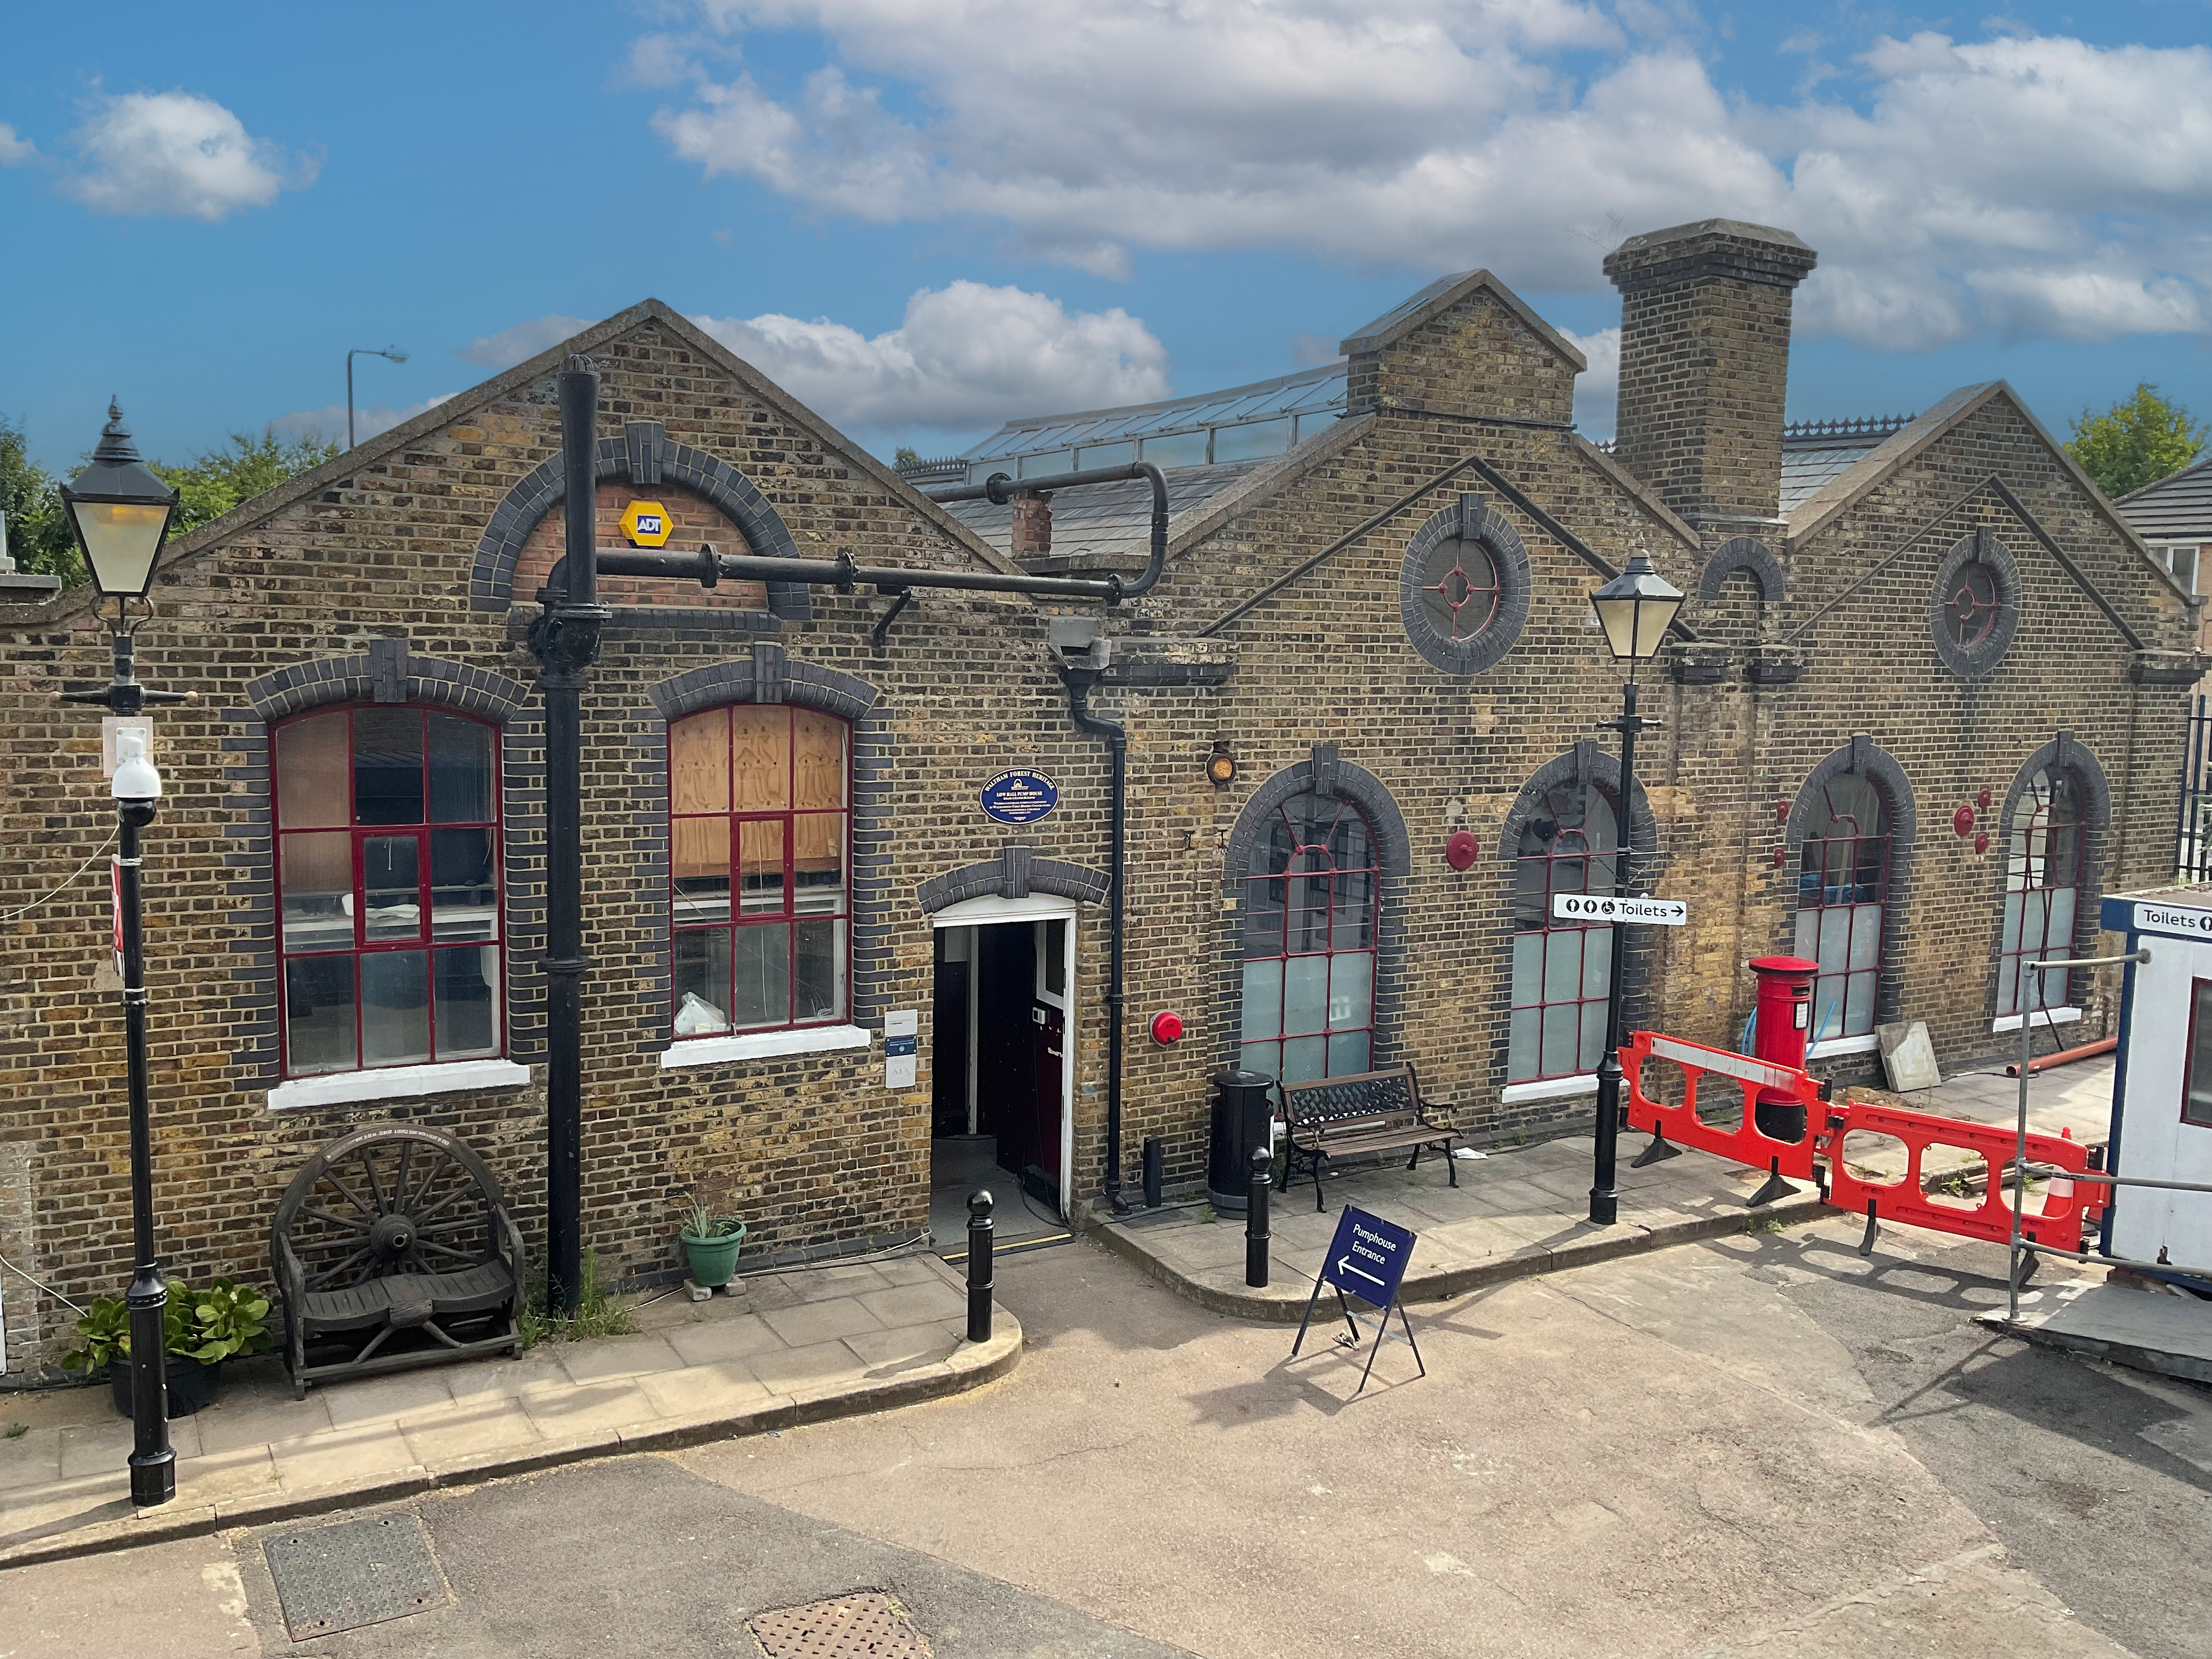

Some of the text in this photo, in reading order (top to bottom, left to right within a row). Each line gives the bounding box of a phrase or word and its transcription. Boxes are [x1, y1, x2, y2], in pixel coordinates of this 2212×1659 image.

[637, 518, 662, 532] ADT
[985, 773, 1008, 792] WALTHAM
[1032, 771, 1056, 791] HERITAGE
[1619, 902, 1667, 917] Toilets
[2144, 909, 2196, 928] Toilets
[1352, 1223, 1397, 1251] Pumphouse
[1352, 1241, 1386, 1265] Entrance
